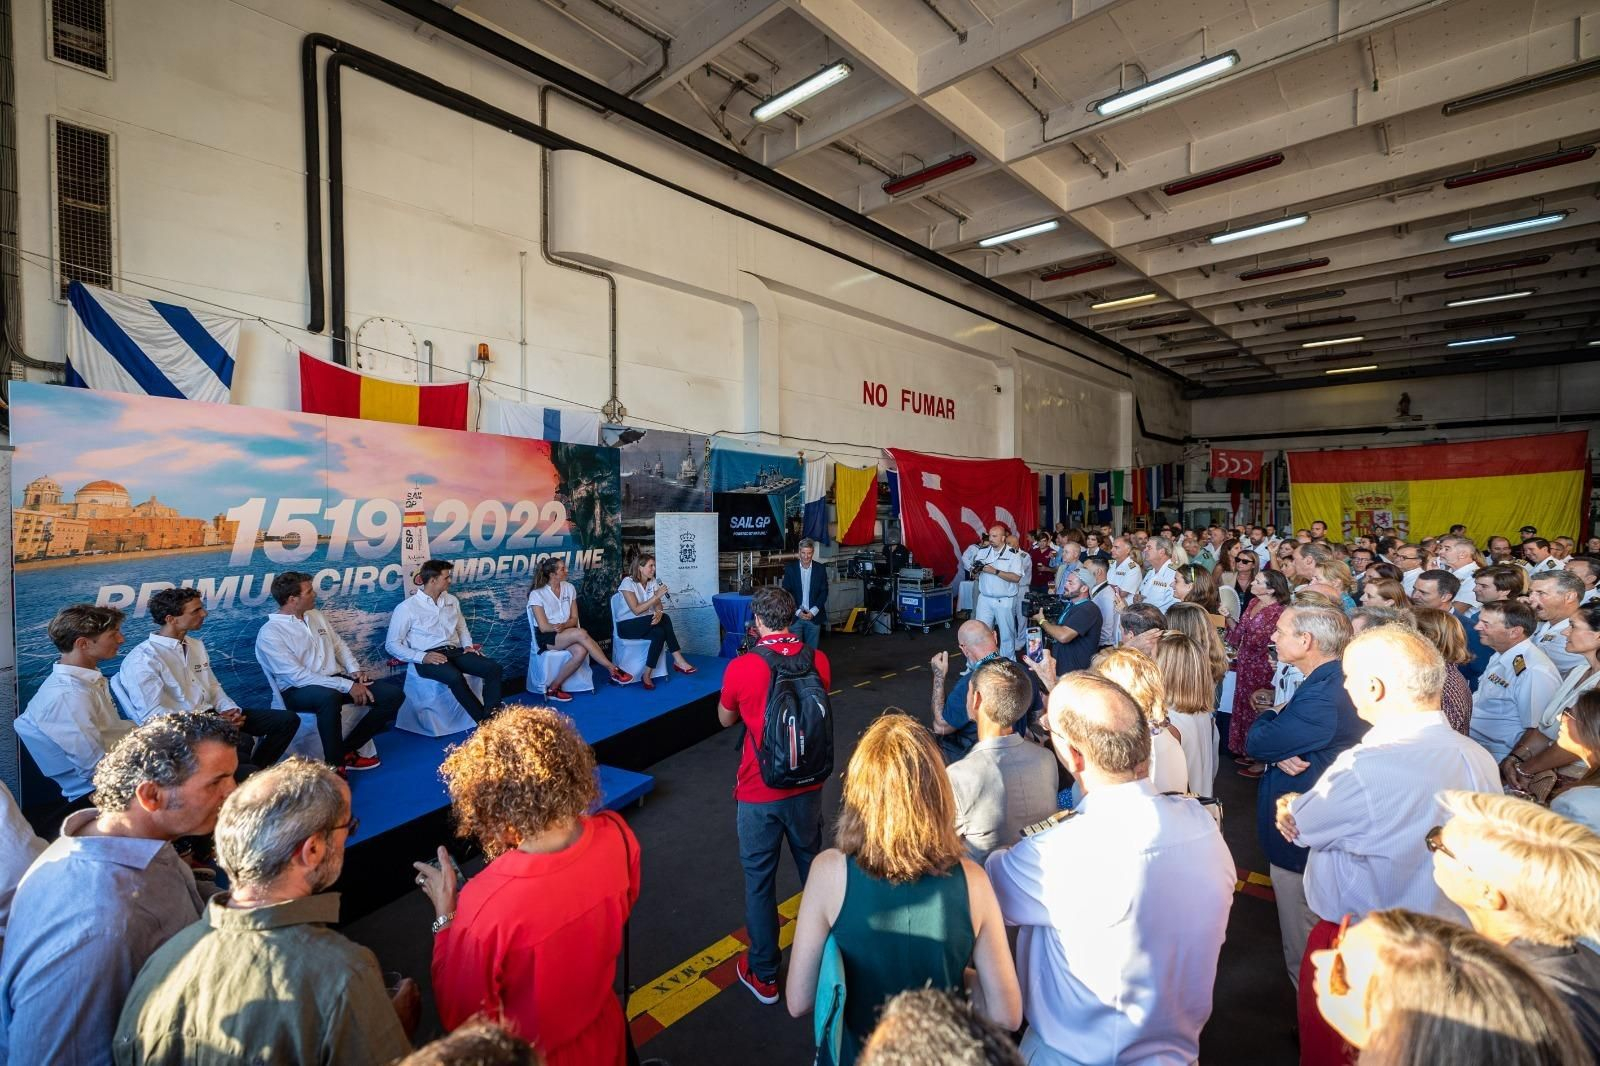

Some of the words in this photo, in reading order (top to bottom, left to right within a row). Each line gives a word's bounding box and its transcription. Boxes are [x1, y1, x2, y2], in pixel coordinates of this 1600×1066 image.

[863, 380, 888, 408] NO
[901, 388, 955, 420] FUMAR
[226, 498, 402, 566] 1519
[429, 499, 567, 551] 2022
[405, 529, 414, 551] ESP
[95, 573, 276, 619] PRMU
[575, 548, 604, 572] ME
